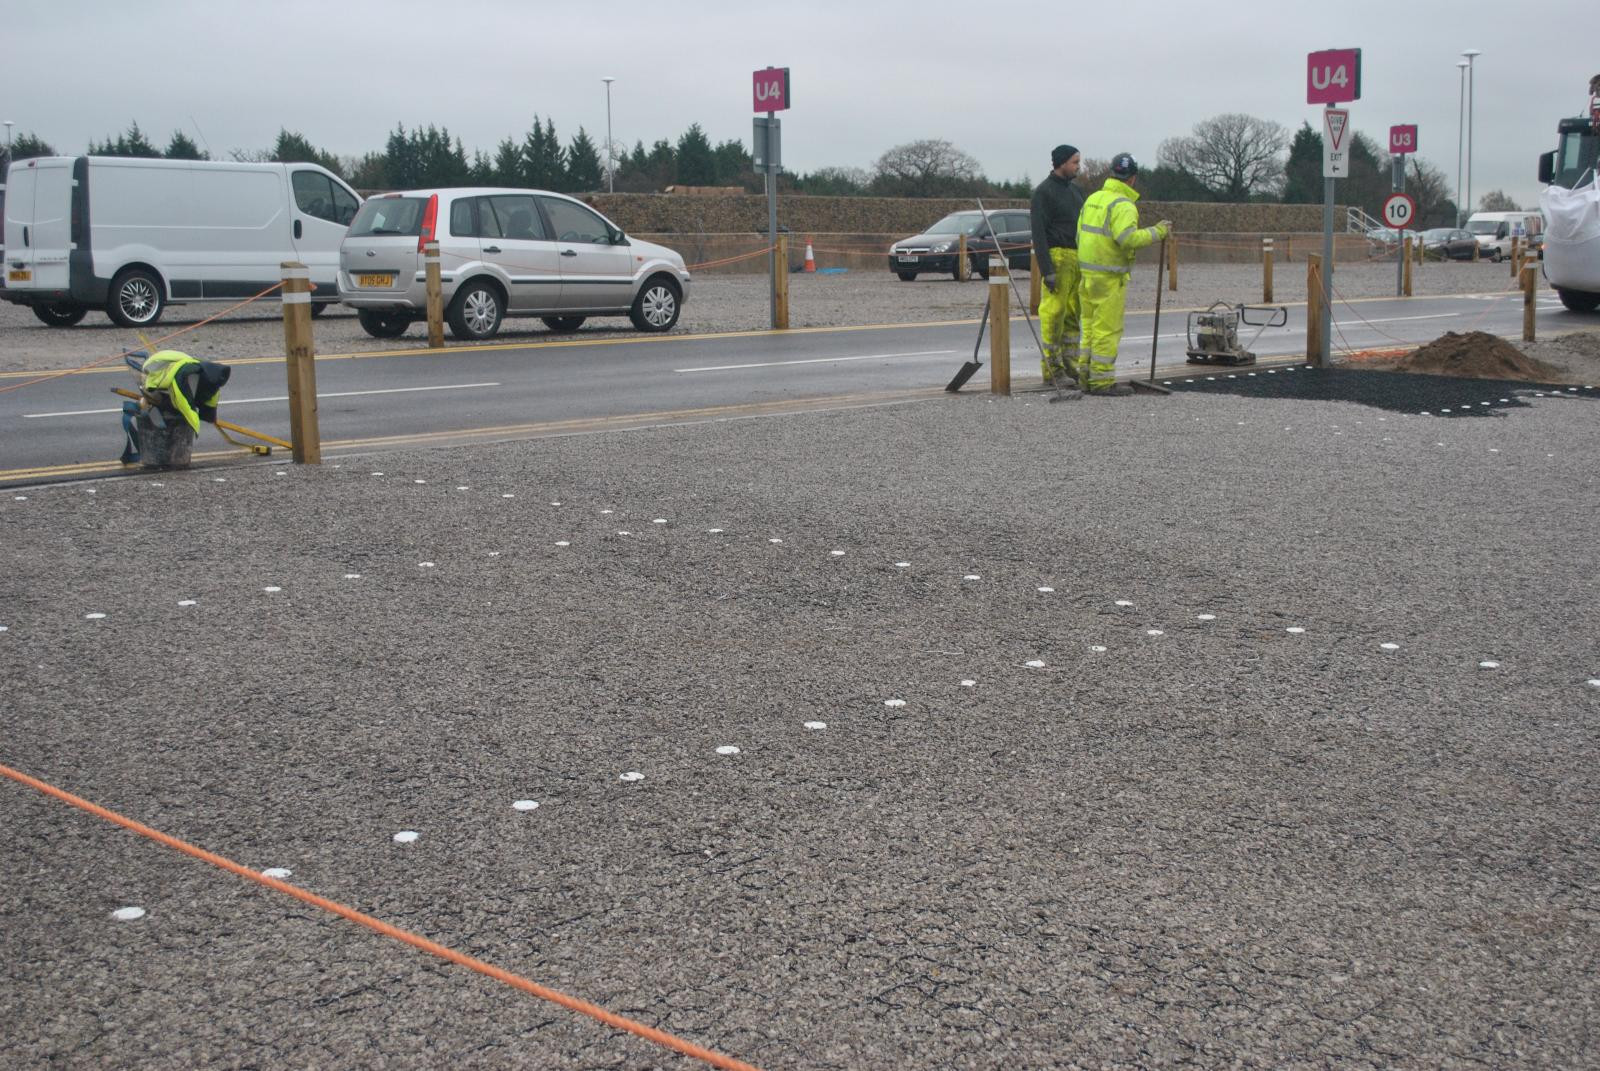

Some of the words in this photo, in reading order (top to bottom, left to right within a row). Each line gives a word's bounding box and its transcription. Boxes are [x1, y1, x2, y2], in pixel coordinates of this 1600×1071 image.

[1312, 65, 1348, 90] U4
[756, 80, 781, 101] U4
[1392, 133, 1411, 147] U3
[1330, 153, 1342, 162] EXIT
[1390, 204, 1407, 218] 10
